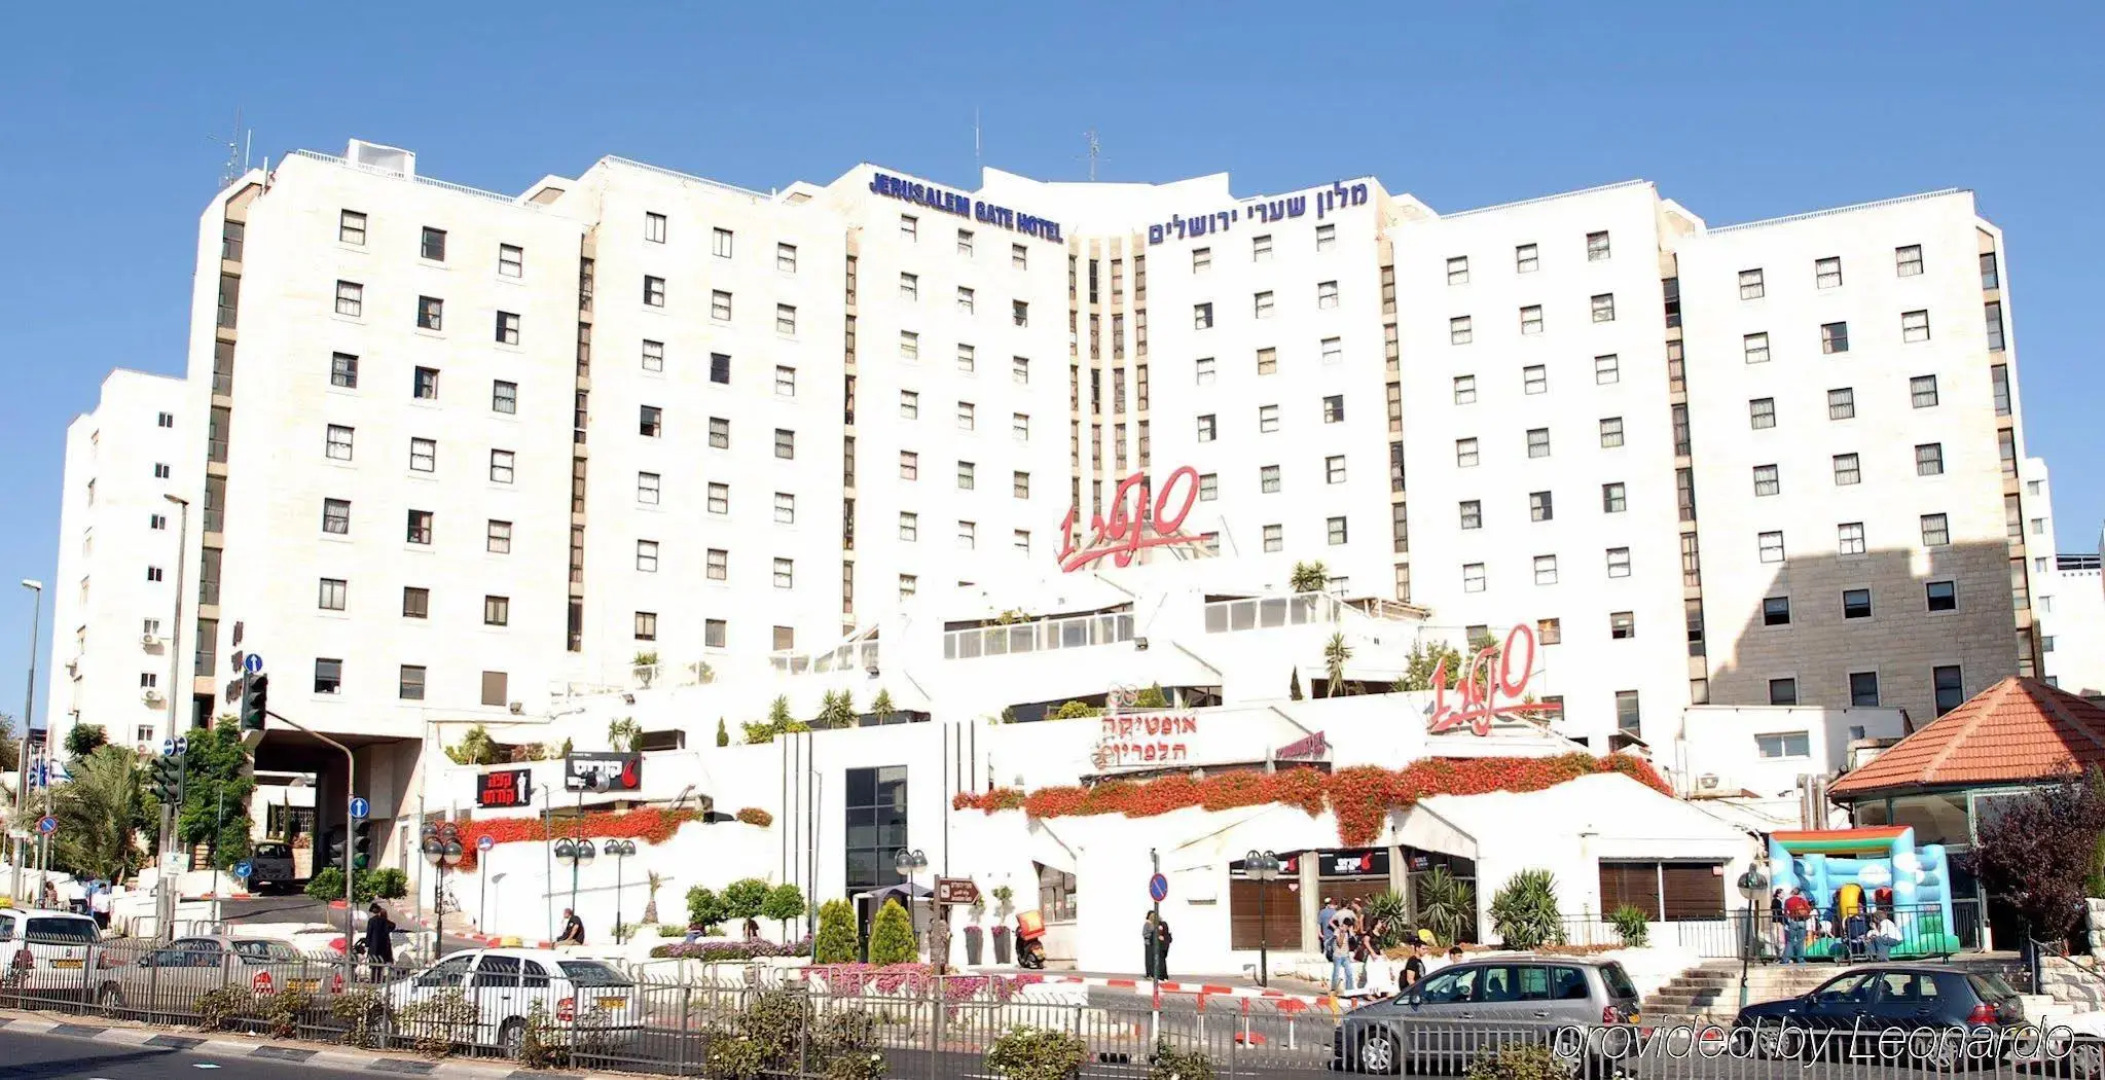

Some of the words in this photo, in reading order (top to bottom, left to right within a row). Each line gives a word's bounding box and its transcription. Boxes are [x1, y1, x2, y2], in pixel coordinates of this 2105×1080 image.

[869, 173, 970, 219] JERUSALEM
[975, 201, 1014, 231] GATE
[1017, 212, 1064, 244] HOTEL
[1247, 196, 1306, 223] שערי
[1317, 181, 1368, 219] מלון
[1149, 209, 1238, 246] ירושלים
[1102, 716, 1197, 739] אופטיקה
[1113, 741, 1187, 767] הלפרין
